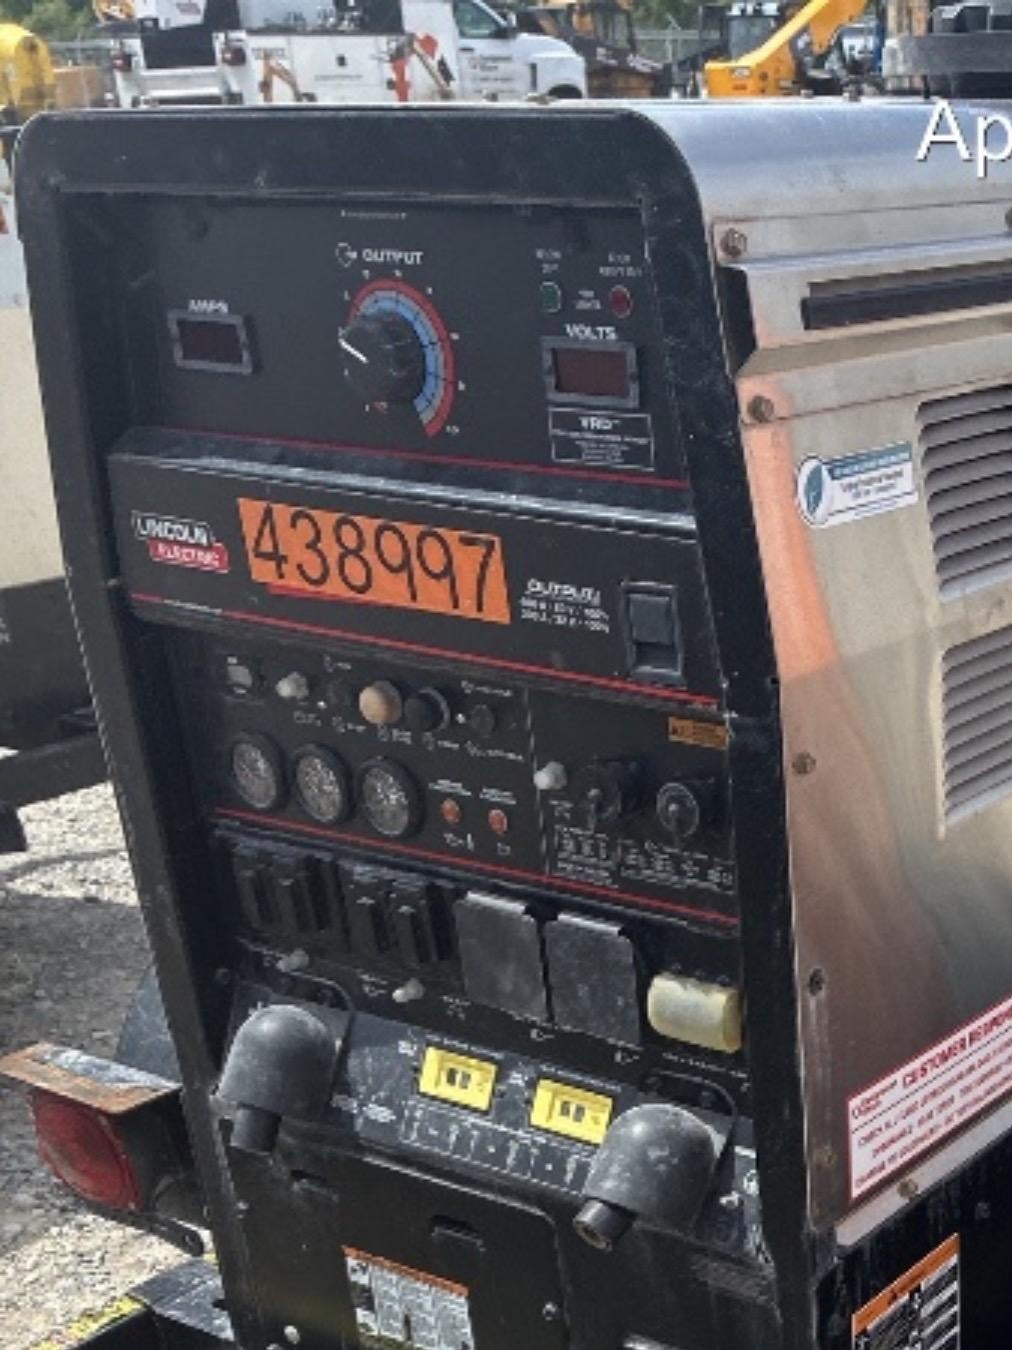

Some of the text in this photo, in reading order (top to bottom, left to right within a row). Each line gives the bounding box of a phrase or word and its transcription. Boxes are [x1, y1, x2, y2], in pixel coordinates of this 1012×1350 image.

[564, 322, 618, 341] VOLTS
[137, 518, 210, 546] LINCOLN
[253, 502, 497, 613] 438997
[902, 1036, 967, 1088] CUSTOMER
